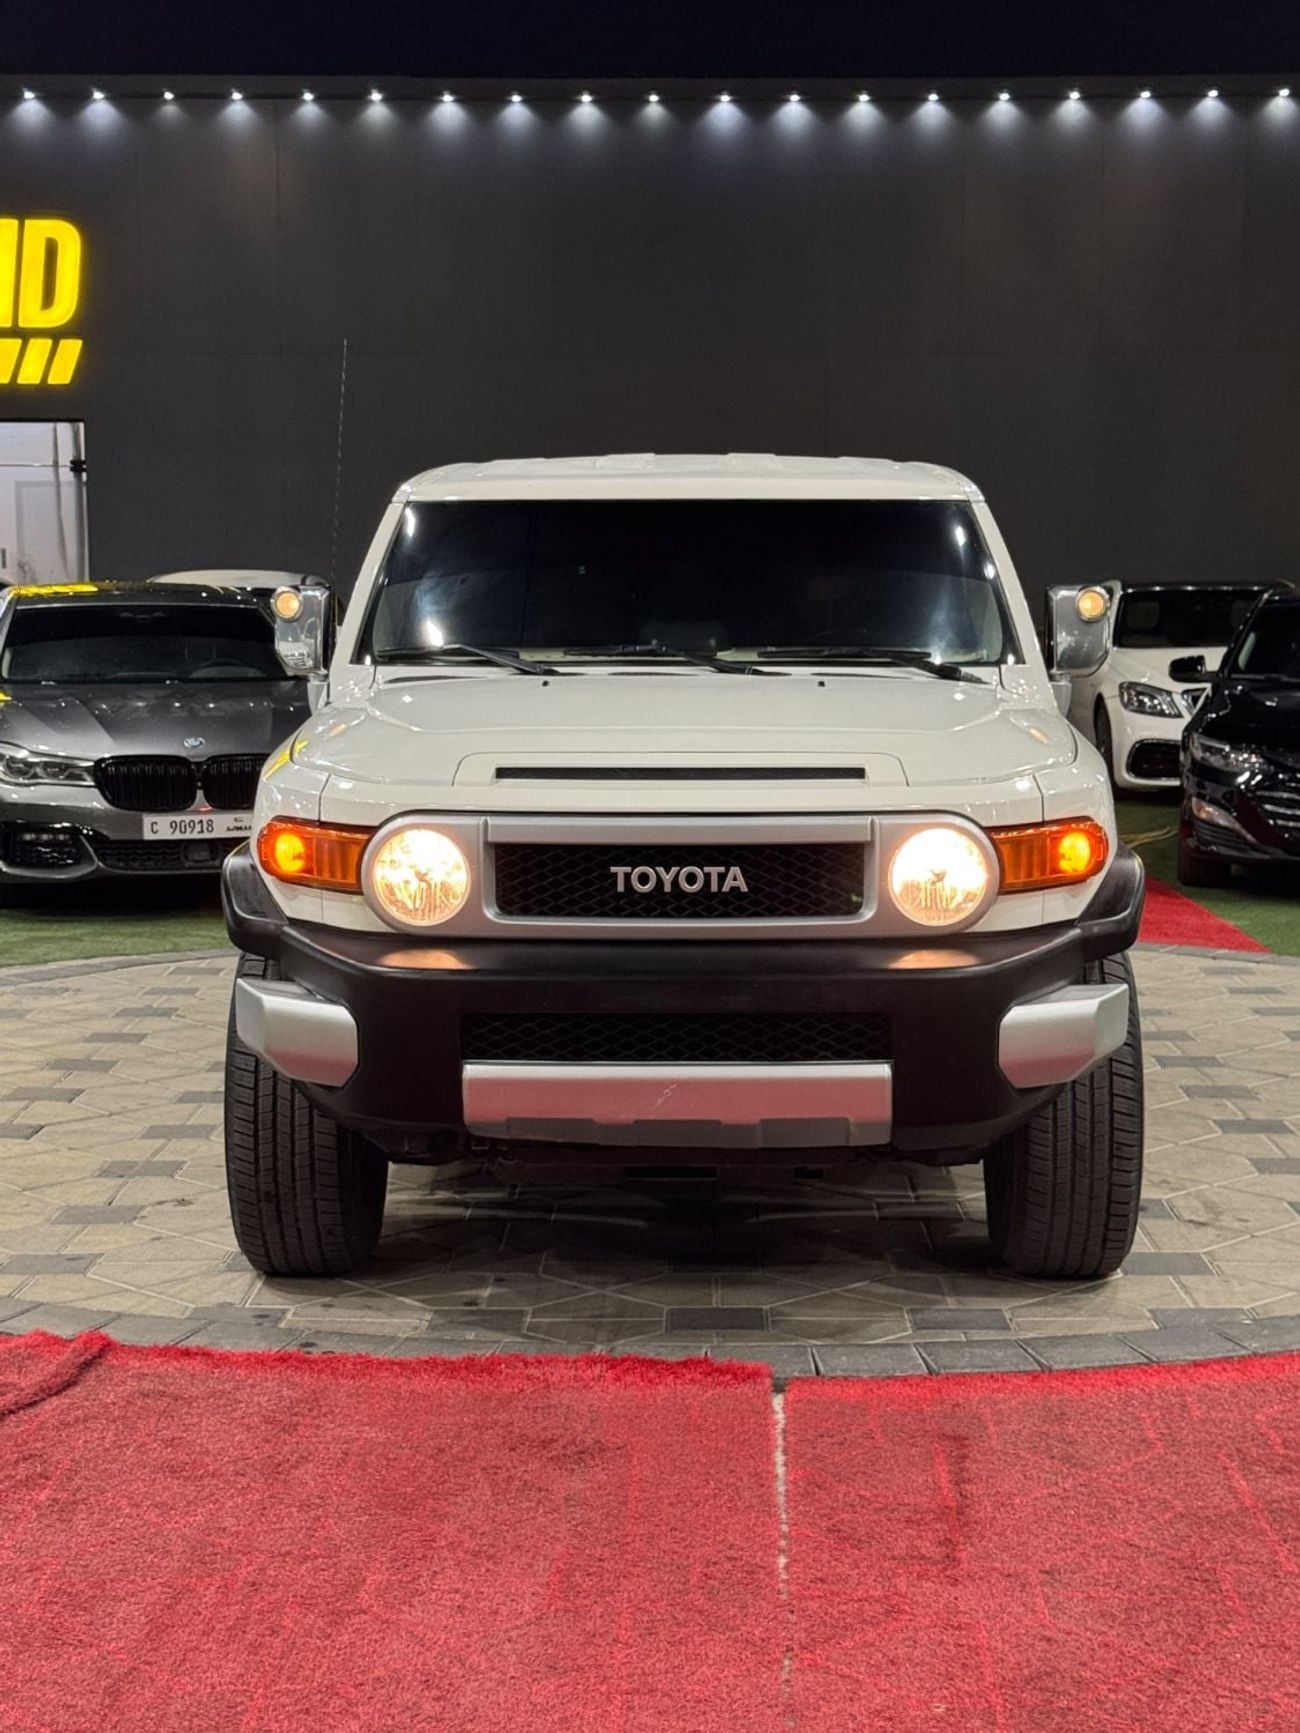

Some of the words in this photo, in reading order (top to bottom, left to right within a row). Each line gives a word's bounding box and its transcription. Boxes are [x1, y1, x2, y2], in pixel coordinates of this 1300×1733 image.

[150, 821, 159, 834] C
[169, 819, 214, 835] 90918
[610, 866, 749, 893] TOYOTA
